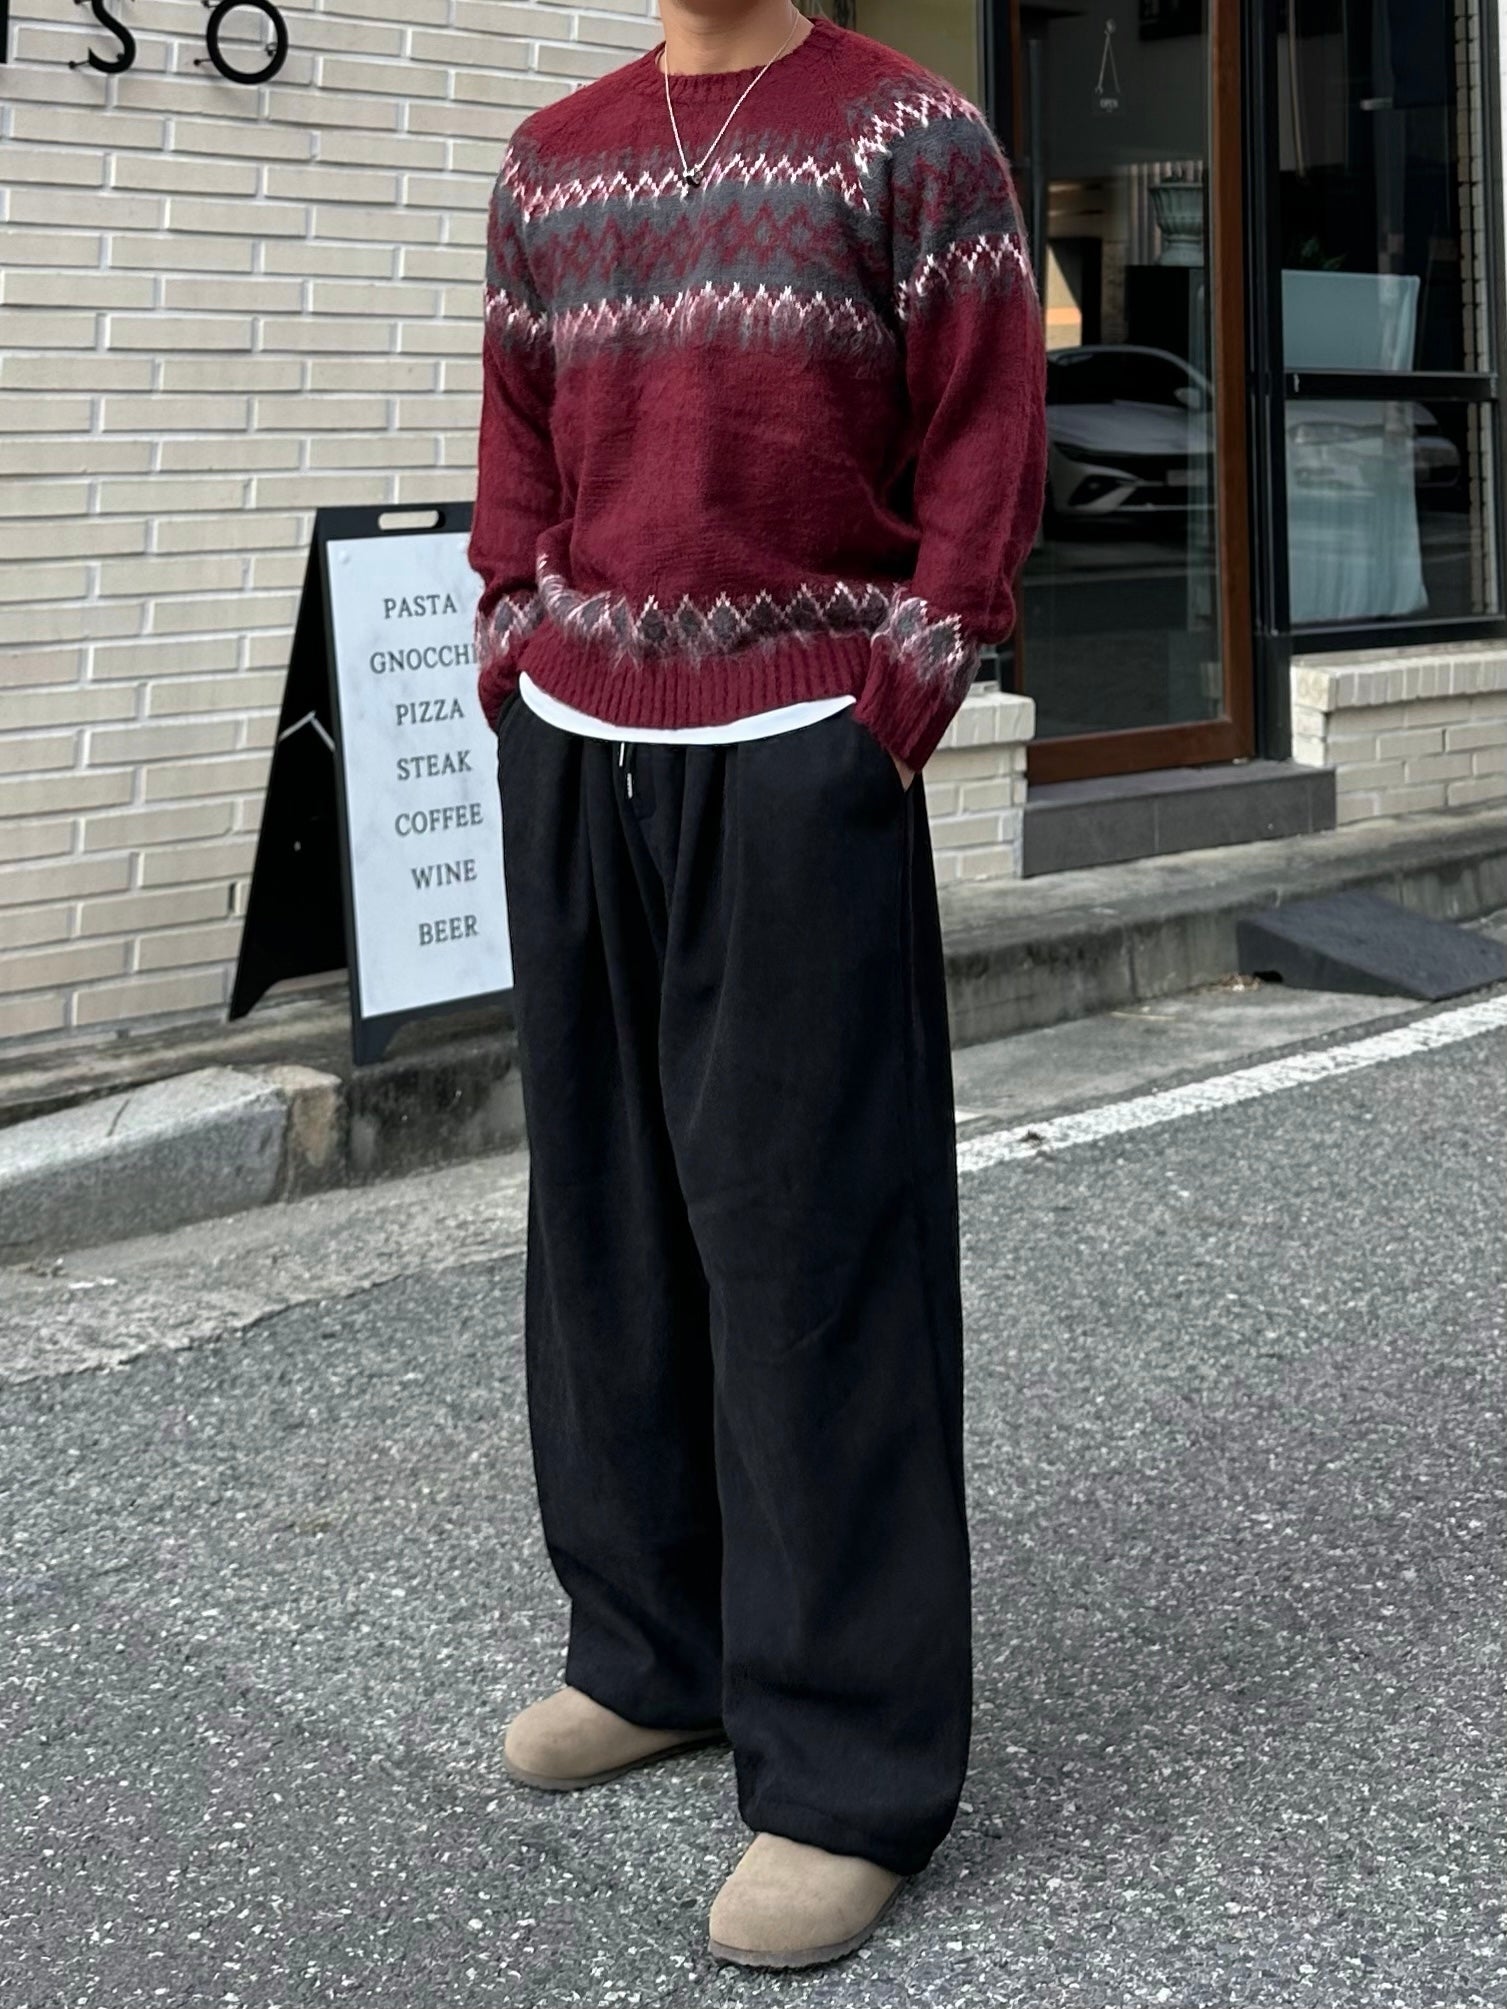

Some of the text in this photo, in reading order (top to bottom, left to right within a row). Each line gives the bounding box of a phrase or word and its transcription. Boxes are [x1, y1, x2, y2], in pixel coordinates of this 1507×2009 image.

[383, 593, 457, 619] PASTA
[395, 698, 465, 726] PIZZA
[396, 750, 472, 780] STEAK
[395, 803, 484, 836] COFFEE
[411, 858, 478, 890] WINE
[418, 914, 479, 946] BEER
